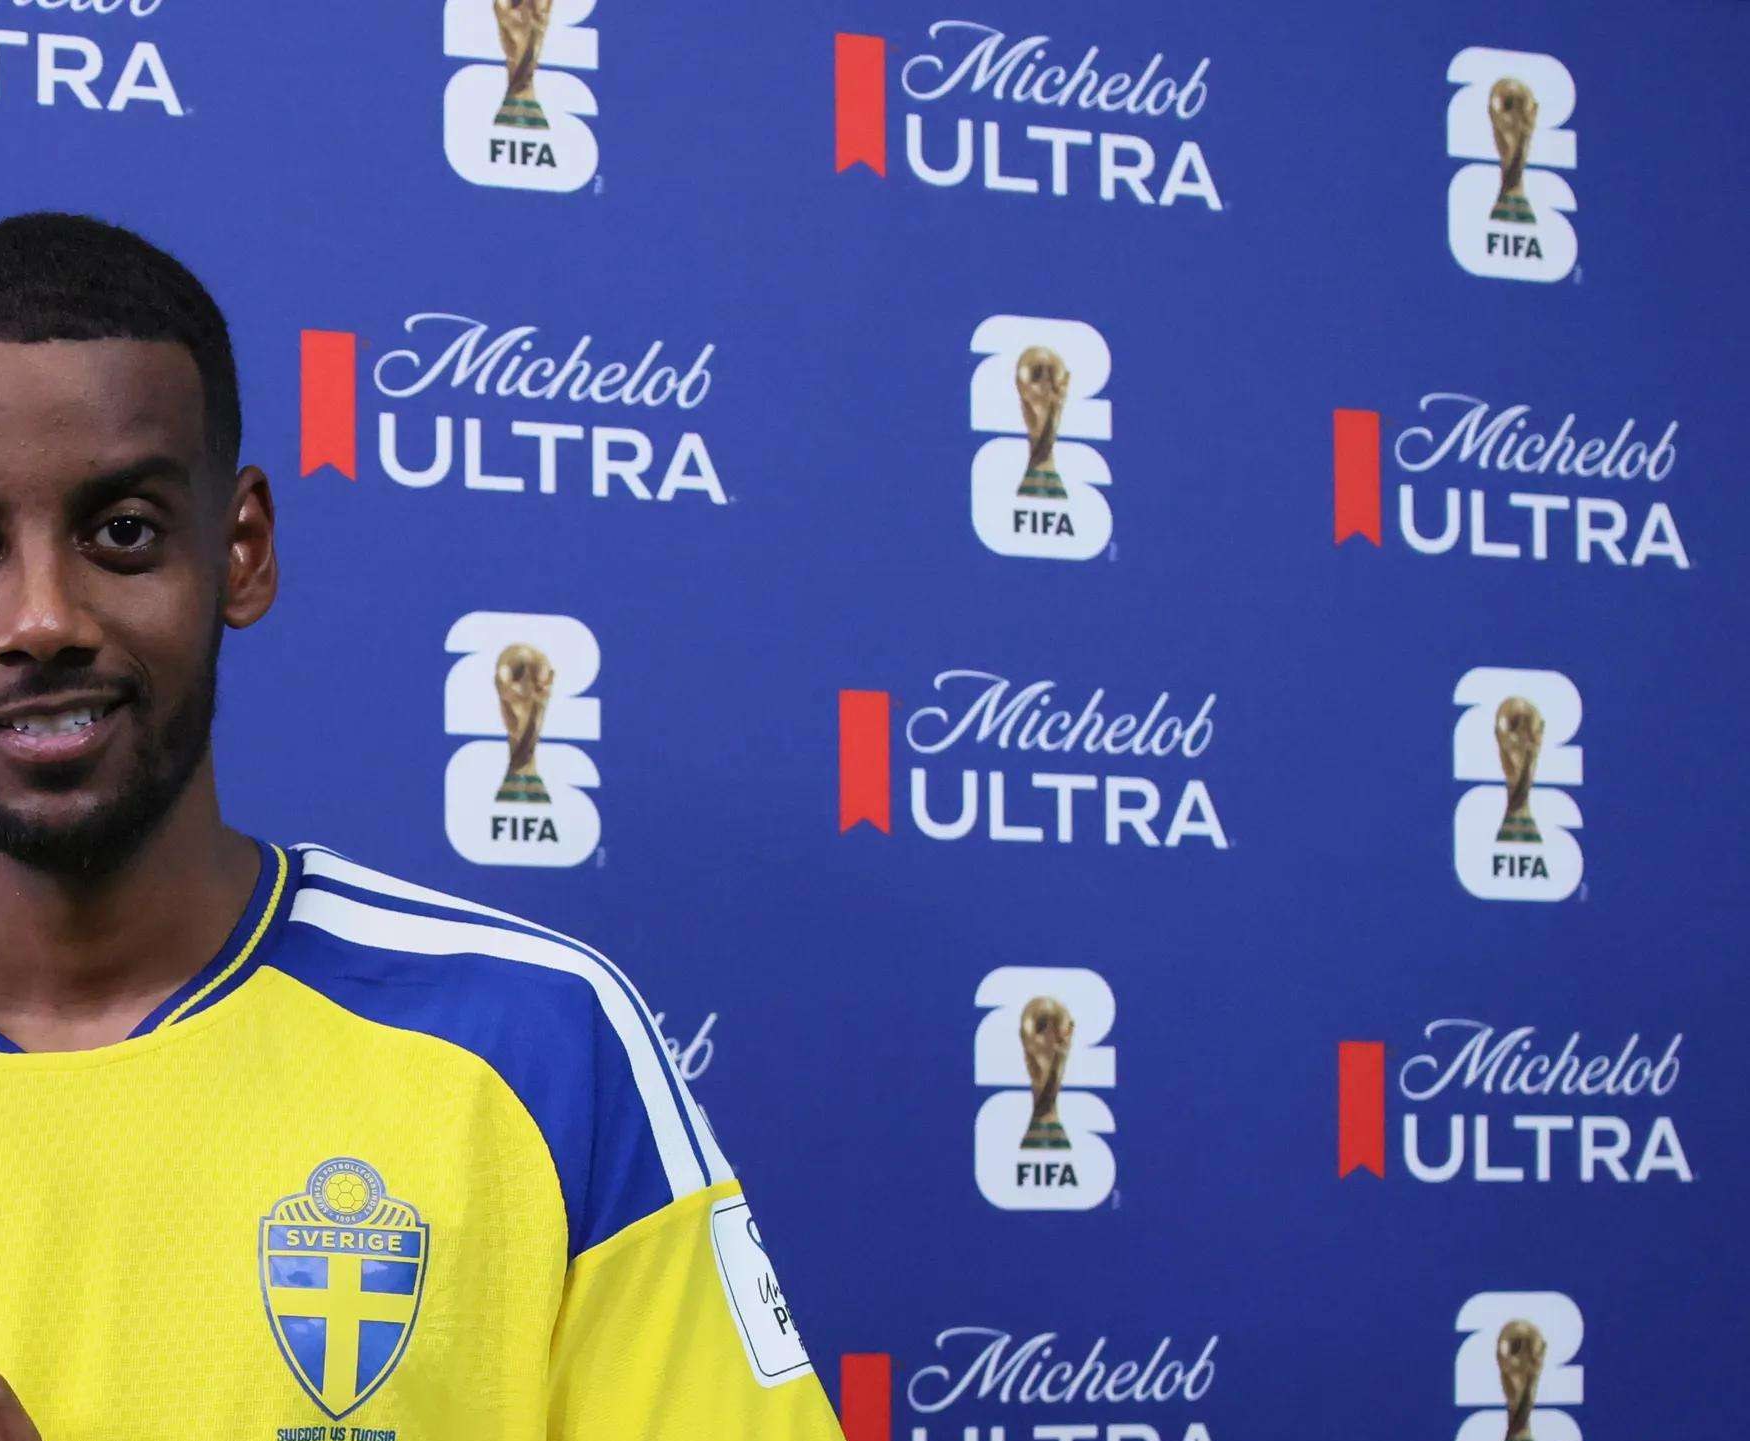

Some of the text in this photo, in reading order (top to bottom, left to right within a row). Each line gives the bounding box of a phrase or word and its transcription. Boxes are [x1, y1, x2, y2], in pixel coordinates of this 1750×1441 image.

[902, 20, 1210, 120] Michelob
[491, 139, 556, 167] FIFA
[906, 113, 1223, 211] ULTRA
[1487, 233, 1542, 259] FIFA
[374, 313, 715, 409] Michelob
[378, 412, 728, 505] ULTRA
[1395, 393, 1678, 481] Michelob
[1014, 510, 1074, 536] FIFA
[1399, 484, 1690, 569] ULTRA
[906, 670, 1216, 757] Michelob
[492, 816, 558, 842] FIFA
[911, 768, 1228, 849] ULTRA
[1493, 855, 1548, 878] FIFA
[1400, 1019, 1682, 1100] Michelob
[1017, 1163, 1077, 1186] FIFA
[1403, 1113, 1693, 1183] ULTRA
[286, 1229, 402, 1251] SVERIGE
[908, 1327, 1218, 1412] Michelob
